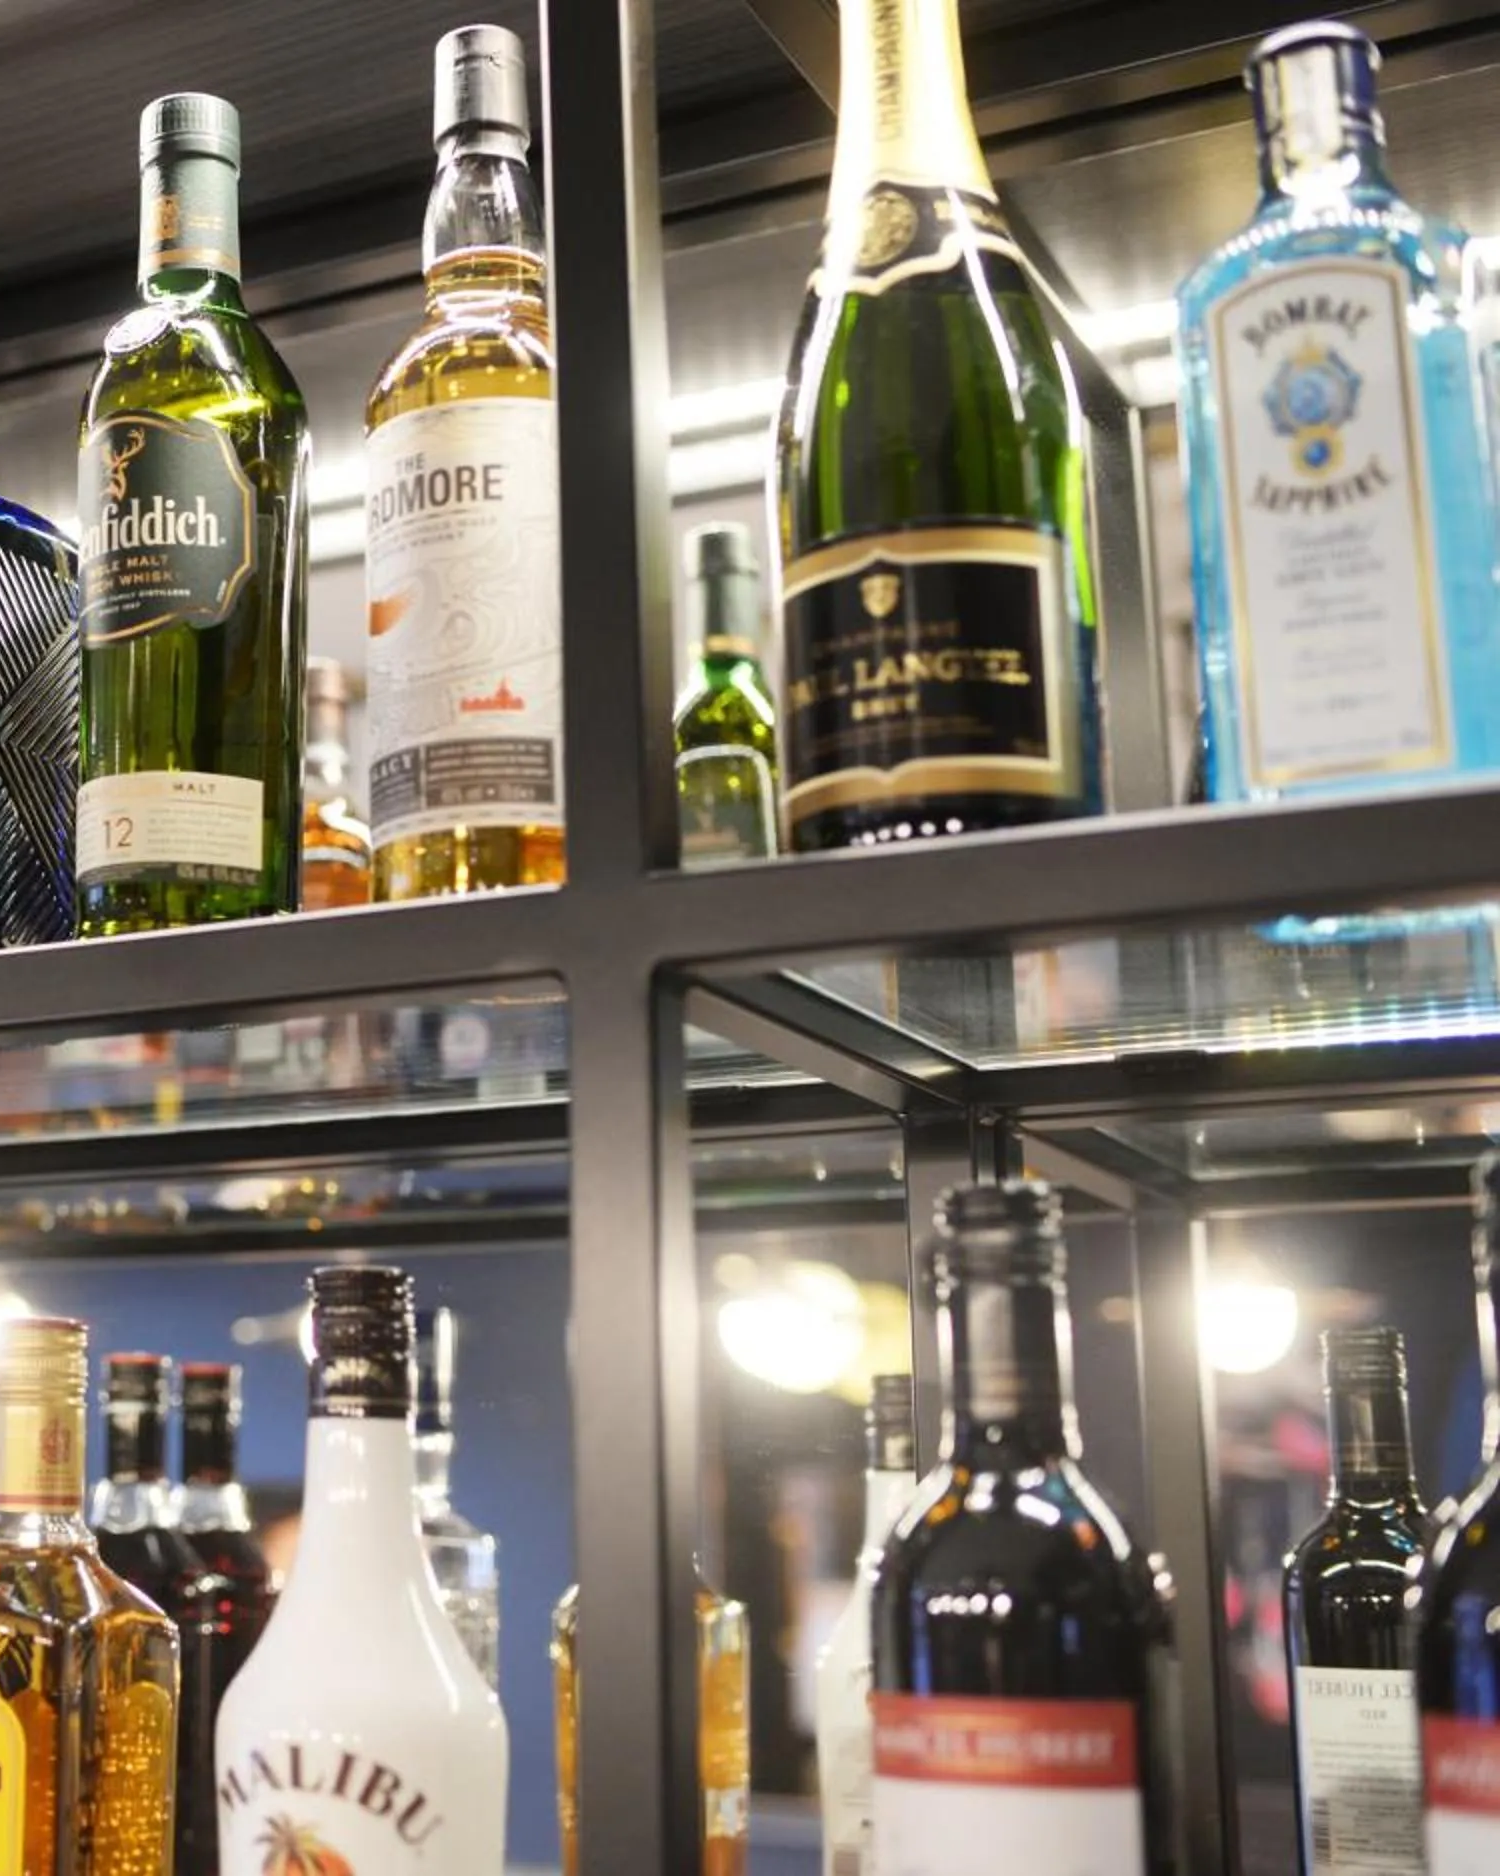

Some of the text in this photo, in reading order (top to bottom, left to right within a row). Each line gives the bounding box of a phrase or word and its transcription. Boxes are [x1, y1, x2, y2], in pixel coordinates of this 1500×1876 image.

[395, 451, 426, 475] THE
[172, 782, 217, 794] MALT
[102, 816, 134, 850] 12
[219, 1743, 445, 1848] MALIBU
